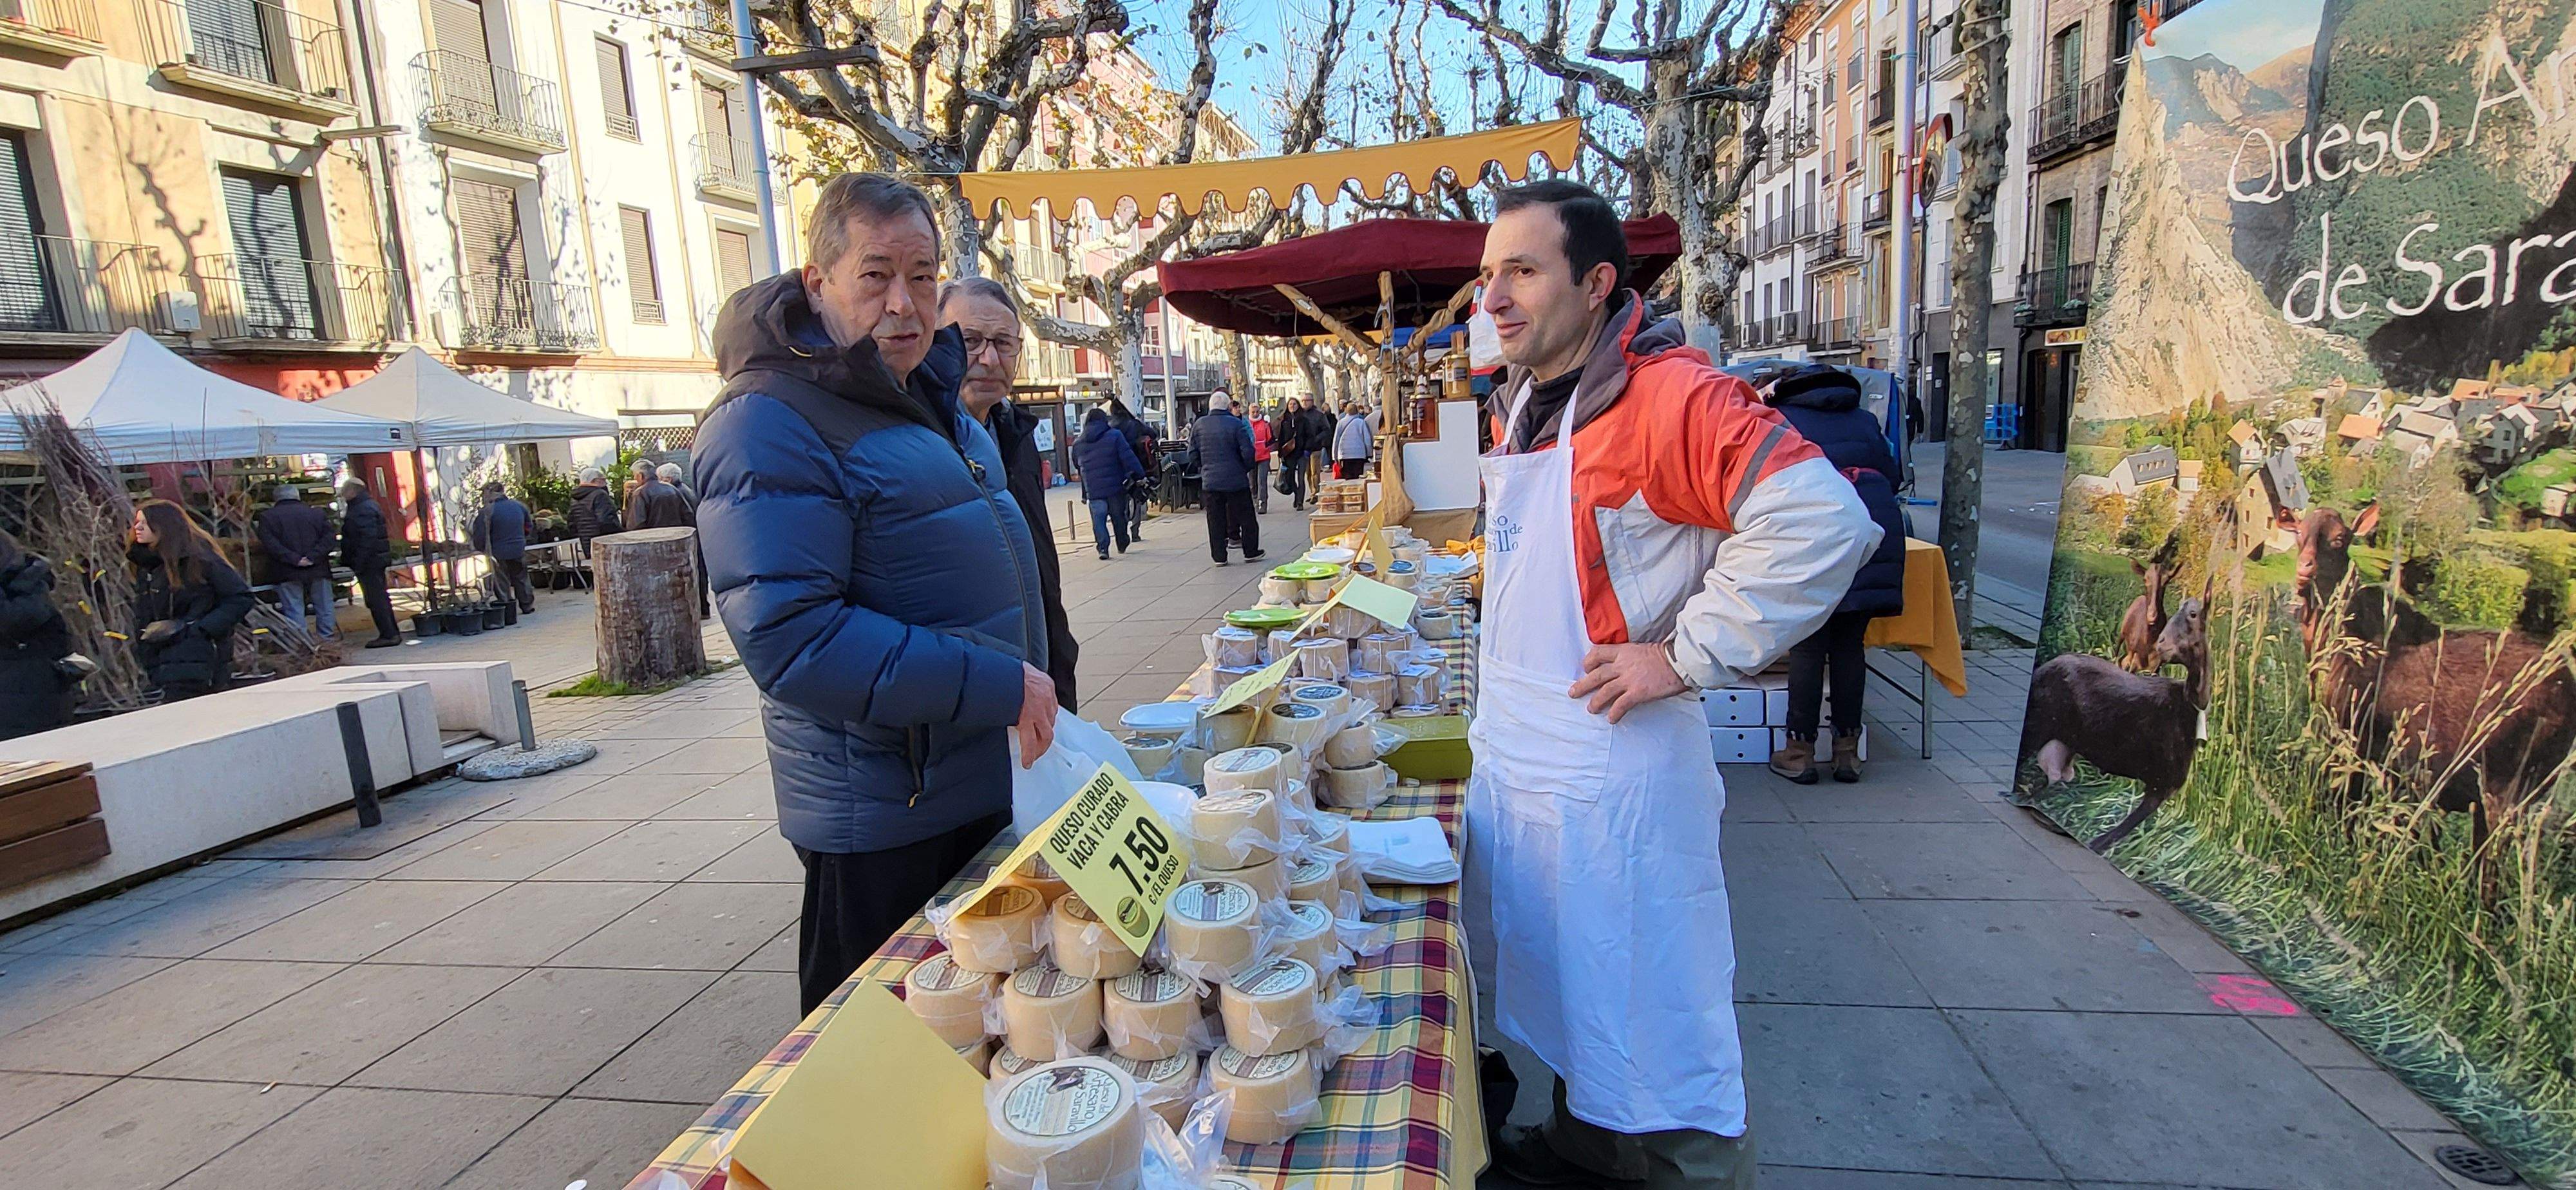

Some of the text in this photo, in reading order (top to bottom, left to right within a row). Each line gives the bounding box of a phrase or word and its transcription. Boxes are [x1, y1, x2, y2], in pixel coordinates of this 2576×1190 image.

[2226, 95, 2440, 204] Queso
[2282, 211, 2576, 323] de Sara
[1509, 523, 1523, 534] de
[1050, 772, 1114, 855] QUESO CURADO
[1066, 790, 1130, 871] VACA Y CABRA
[1108, 816, 1170, 897] 7.50
[1158, 855, 1179, 886] QUESO
[1067, 1090, 1087, 1132] Saravillo
[1084, 1072, 1106, 1120] Artesano
[1100, 1077, 1115, 1102] Queso
